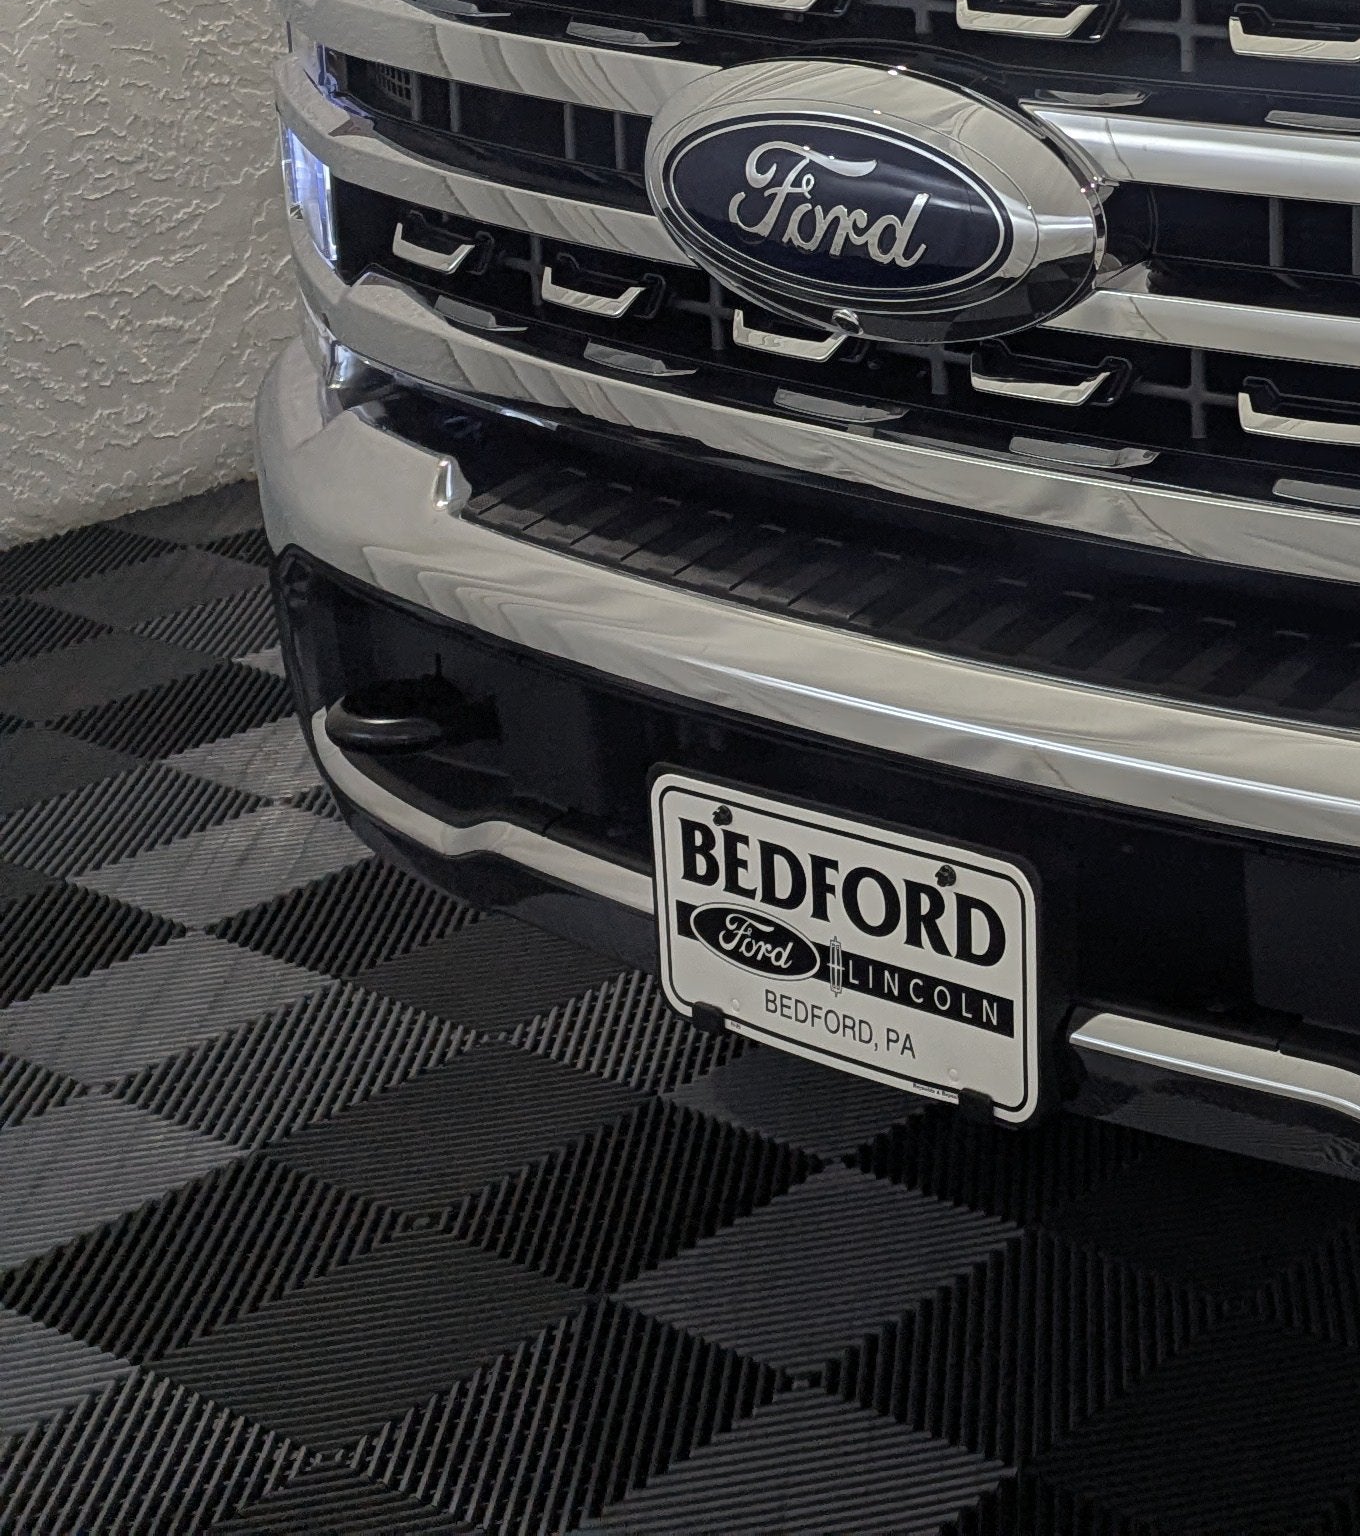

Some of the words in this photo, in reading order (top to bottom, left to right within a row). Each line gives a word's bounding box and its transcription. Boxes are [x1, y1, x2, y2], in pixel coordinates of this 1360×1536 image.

[728, 140, 931, 268] Ford
[677, 816, 1007, 967] BEDFORD
[717, 912, 794, 969] Ford
[764, 988, 880, 1052] BEDFORD,
[885, 1032, 917, 1059] PA
[848, 964, 999, 1027] LINCOLN
